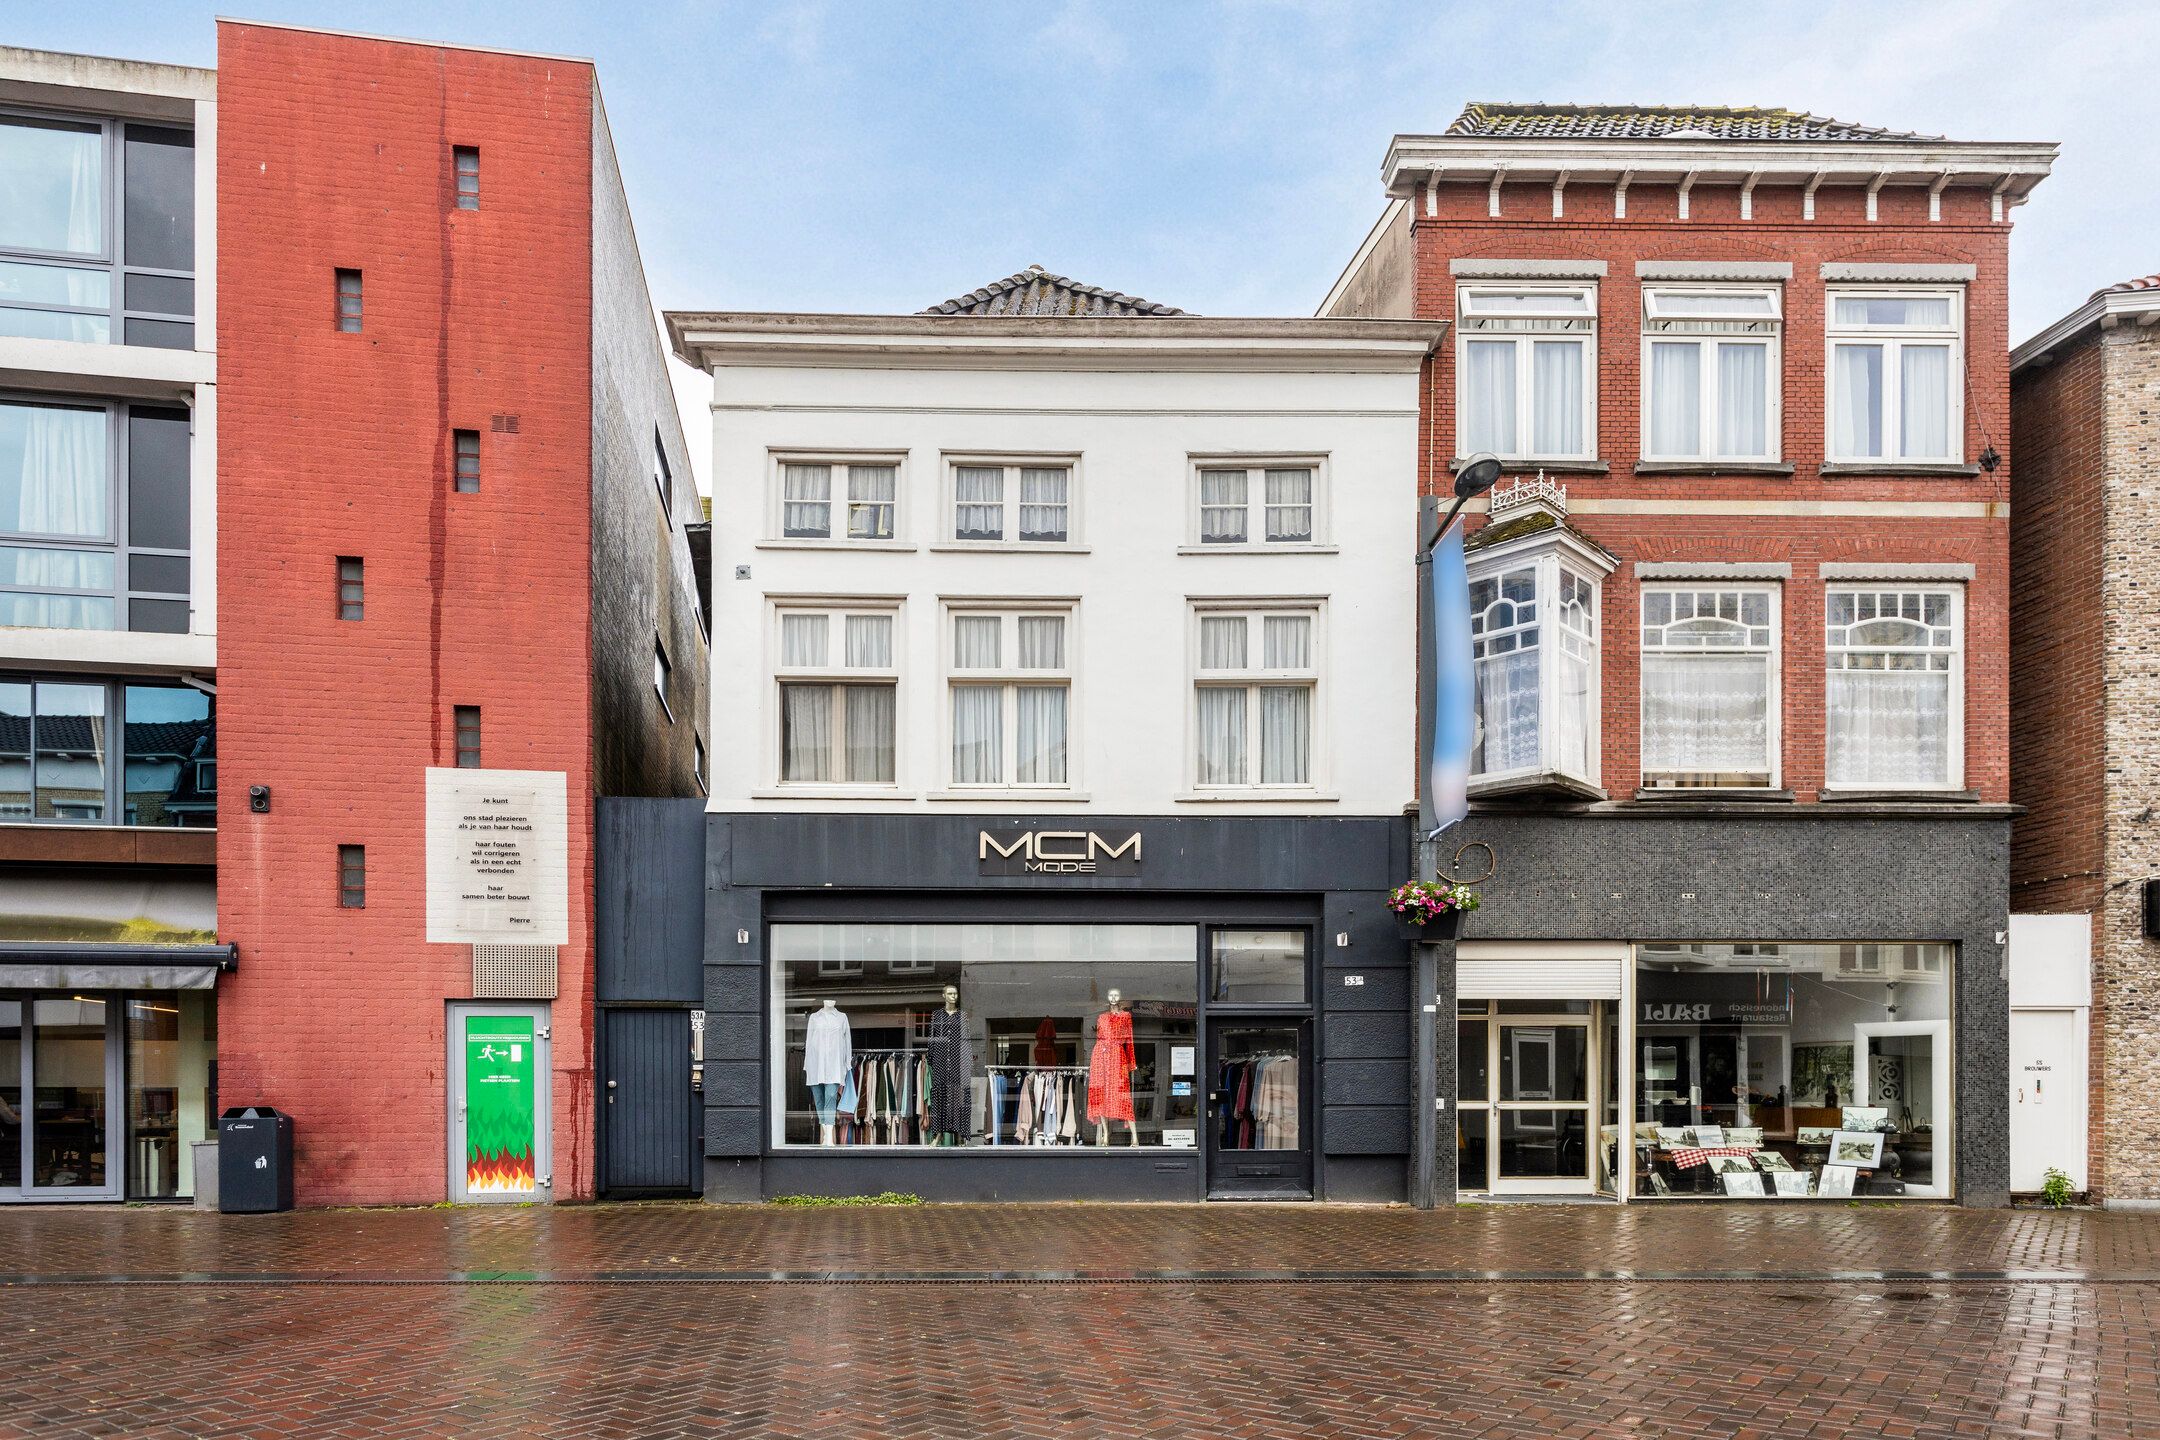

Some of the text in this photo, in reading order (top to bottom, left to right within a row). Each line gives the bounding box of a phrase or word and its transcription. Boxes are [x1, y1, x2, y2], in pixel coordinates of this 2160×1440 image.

[478, 814, 494, 822] stad
[495, 815, 528, 823] plezieren
[458, 822, 468, 830] als
[469, 823, 477, 831] je
[493, 823, 509, 831] haar
[493, 841, 517, 849] fouten
[979, 830, 1142, 861] MCM
[484, 849, 521, 858] corrigeren
[506, 858, 522, 866] echt
[476, 867, 515, 875] verbonden
[1025, 862, 1097, 873] MODE
[487, 884, 504, 892] haar
[486, 893, 506, 901] beter
[691, 1012, 704, 1020] 53A
